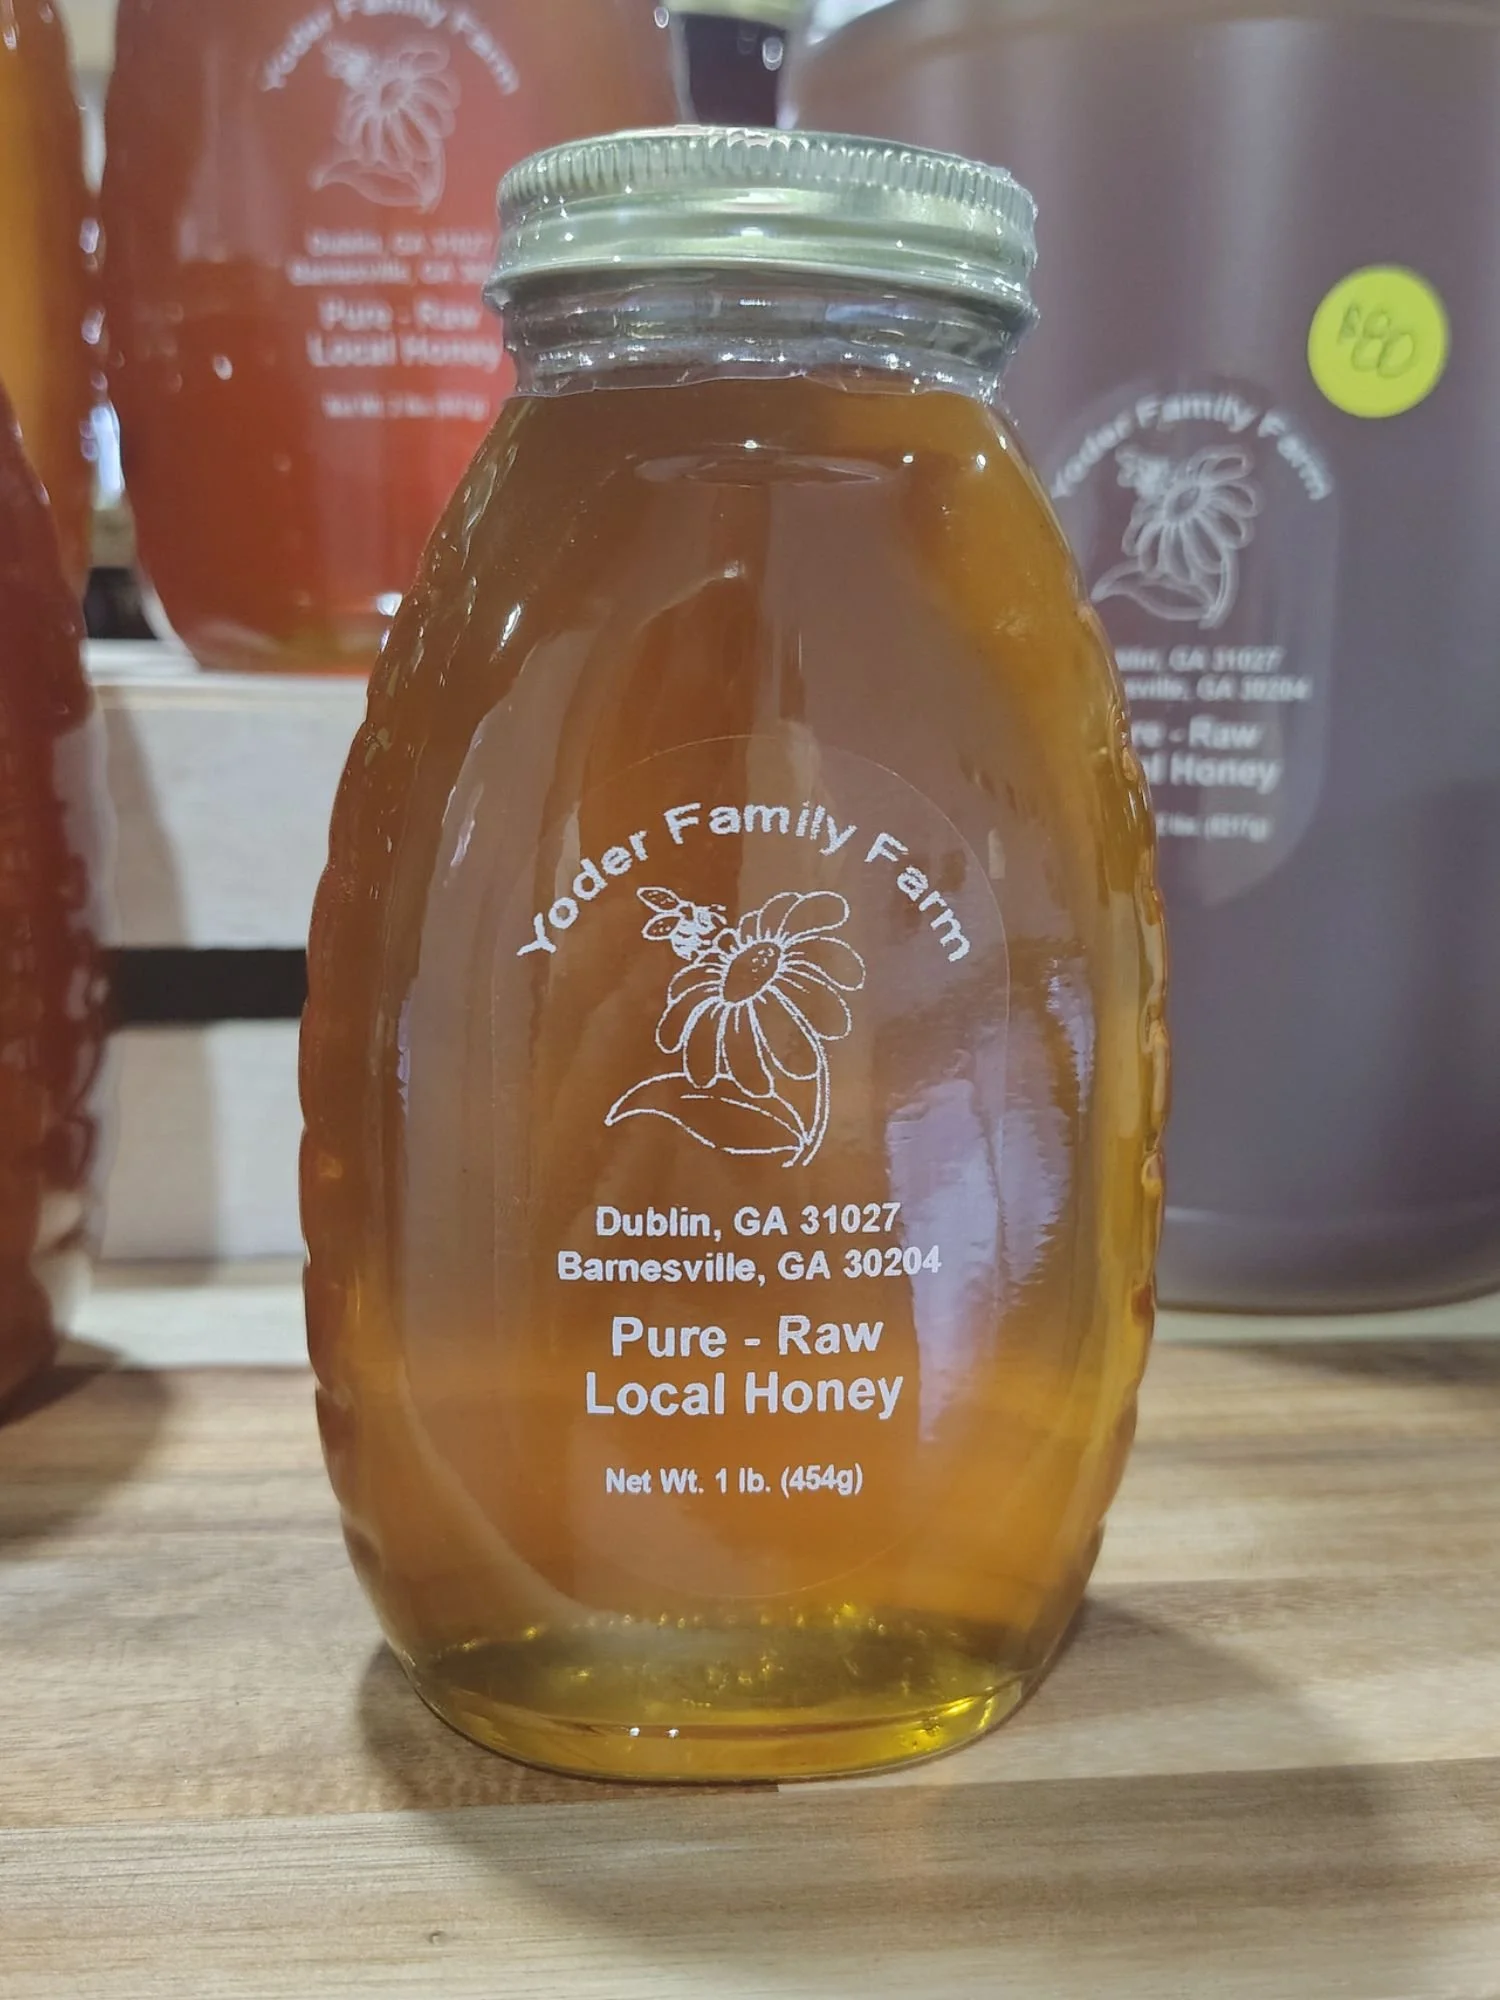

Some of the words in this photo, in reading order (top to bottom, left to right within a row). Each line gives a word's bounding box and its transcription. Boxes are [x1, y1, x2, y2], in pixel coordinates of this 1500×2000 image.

[1136, 391, 1260, 433] Family
[1258, 410, 1334, 500] Farm
[1189, 716, 1264, 749] Raw
[1170, 754, 1280, 793] Honey
[517, 831, 648, 957] Yoder
[663, 801, 857, 856] Family
[865, 832, 972, 963] Farm
[596, 1206, 722, 1241] Dublin,
[733, 1206, 788, 1236] GA
[800, 1202, 901, 1235] 31027
[557, 1250, 766, 1287] Barnesville,
[777, 1251, 831, 1280] GA
[842, 1245, 941, 1278] 30204
[611, 1316, 727, 1358] Pure
[778, 1315, 884, 1356] Raw
[585, 1371, 725, 1416] Local
[744, 1371, 903, 1420] Honey
[605, 1468, 651, 1493] Net
[659, 1467, 704, 1494] Wt.
[715, 1468, 727, 1493] 1
[739, 1467, 771, 1493] lb.
[780, 1463, 863, 1499] (454g)
